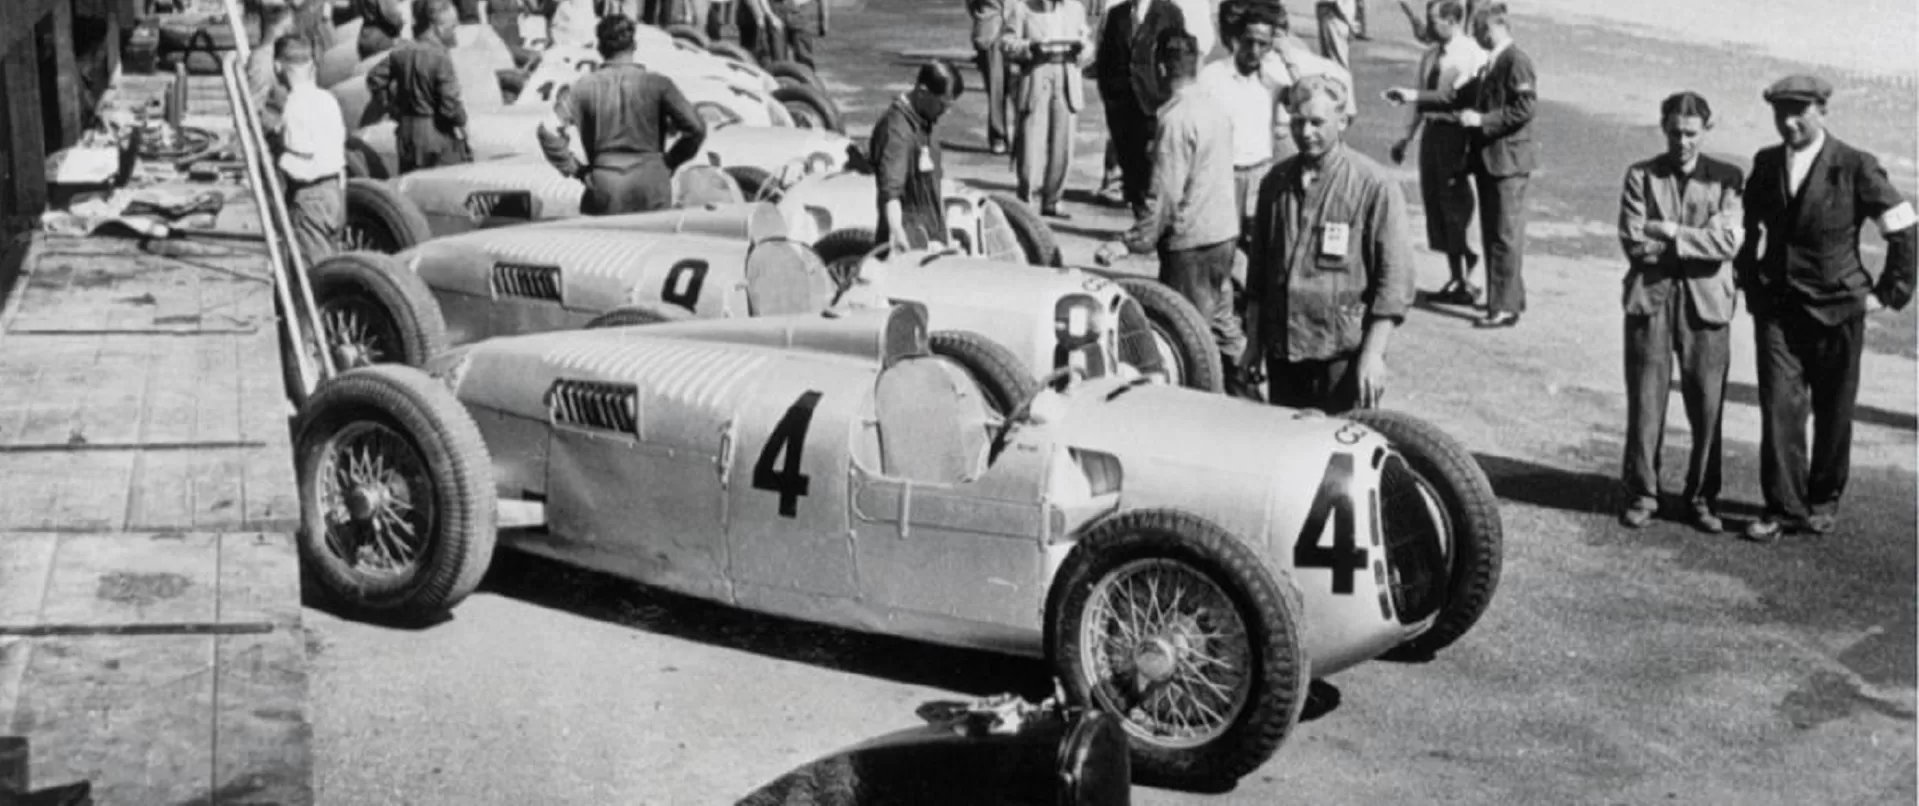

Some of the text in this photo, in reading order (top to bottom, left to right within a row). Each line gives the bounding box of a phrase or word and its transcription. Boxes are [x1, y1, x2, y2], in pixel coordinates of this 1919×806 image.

[1054, 292, 1106, 388] 8
[752, 390, 824, 518] 4
[1293, 451, 1369, 595] 4
